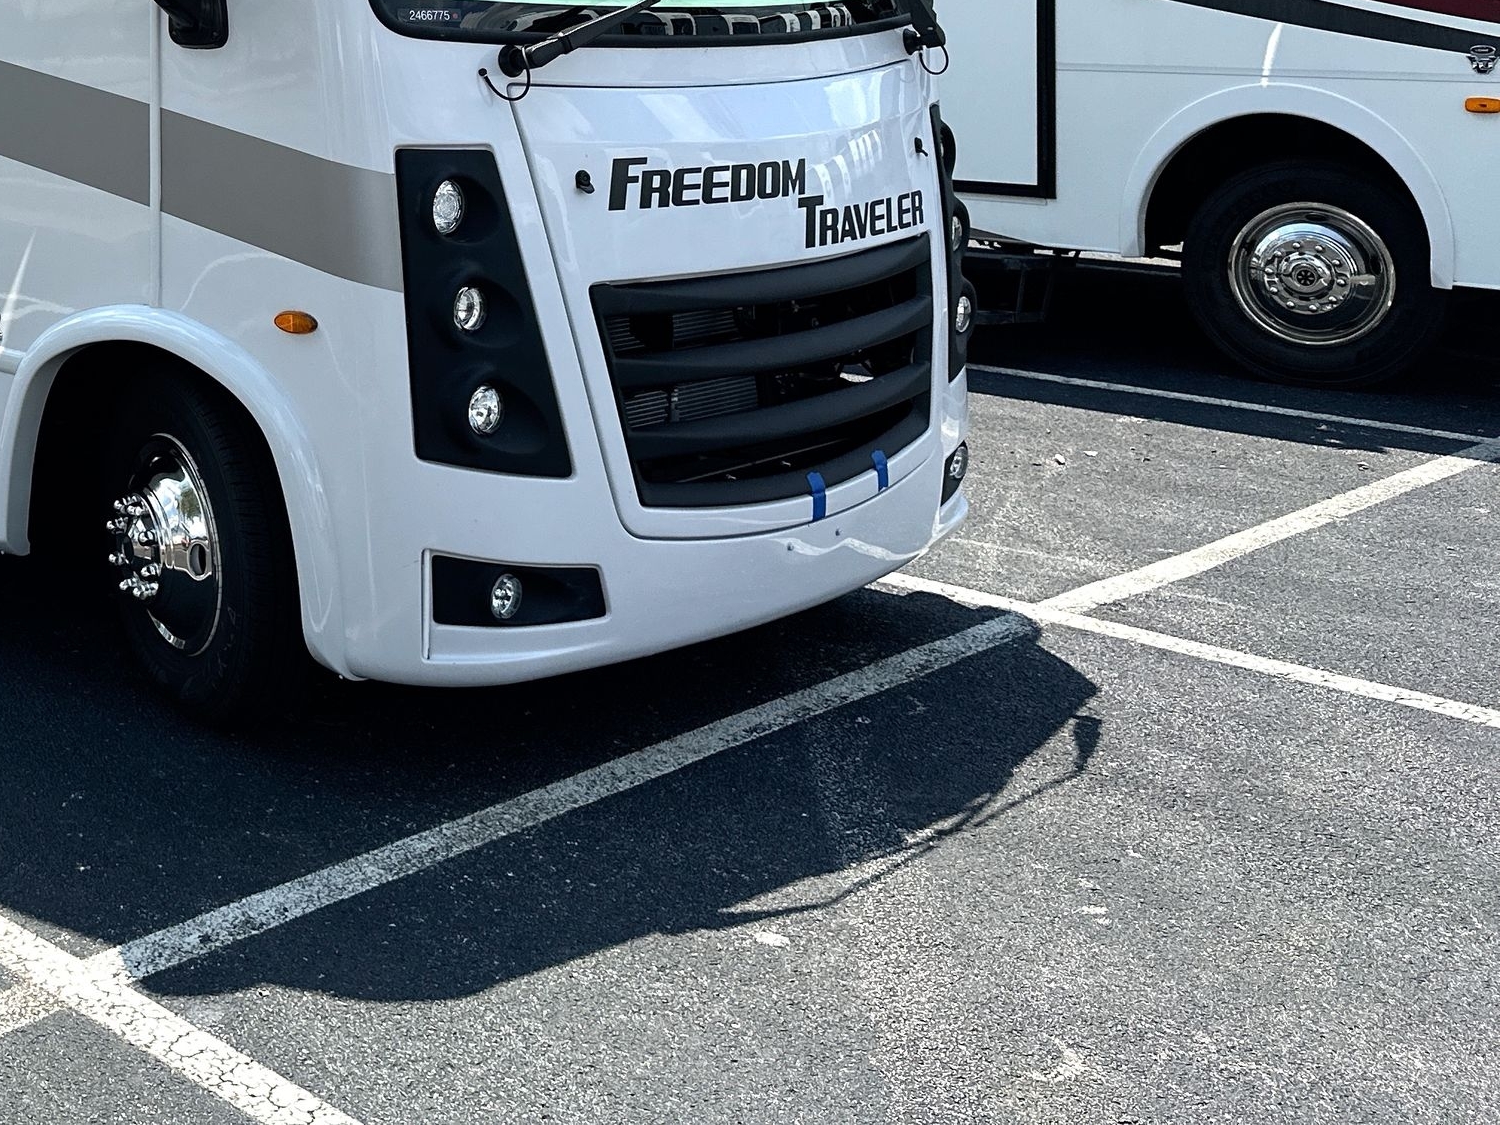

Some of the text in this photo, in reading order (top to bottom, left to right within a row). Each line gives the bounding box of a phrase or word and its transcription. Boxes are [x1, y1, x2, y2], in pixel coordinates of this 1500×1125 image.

[409, 9, 451, 21] 2466775
[608, 157, 806, 211] FREEDOM
[798, 189, 925, 249] TRAVELER
